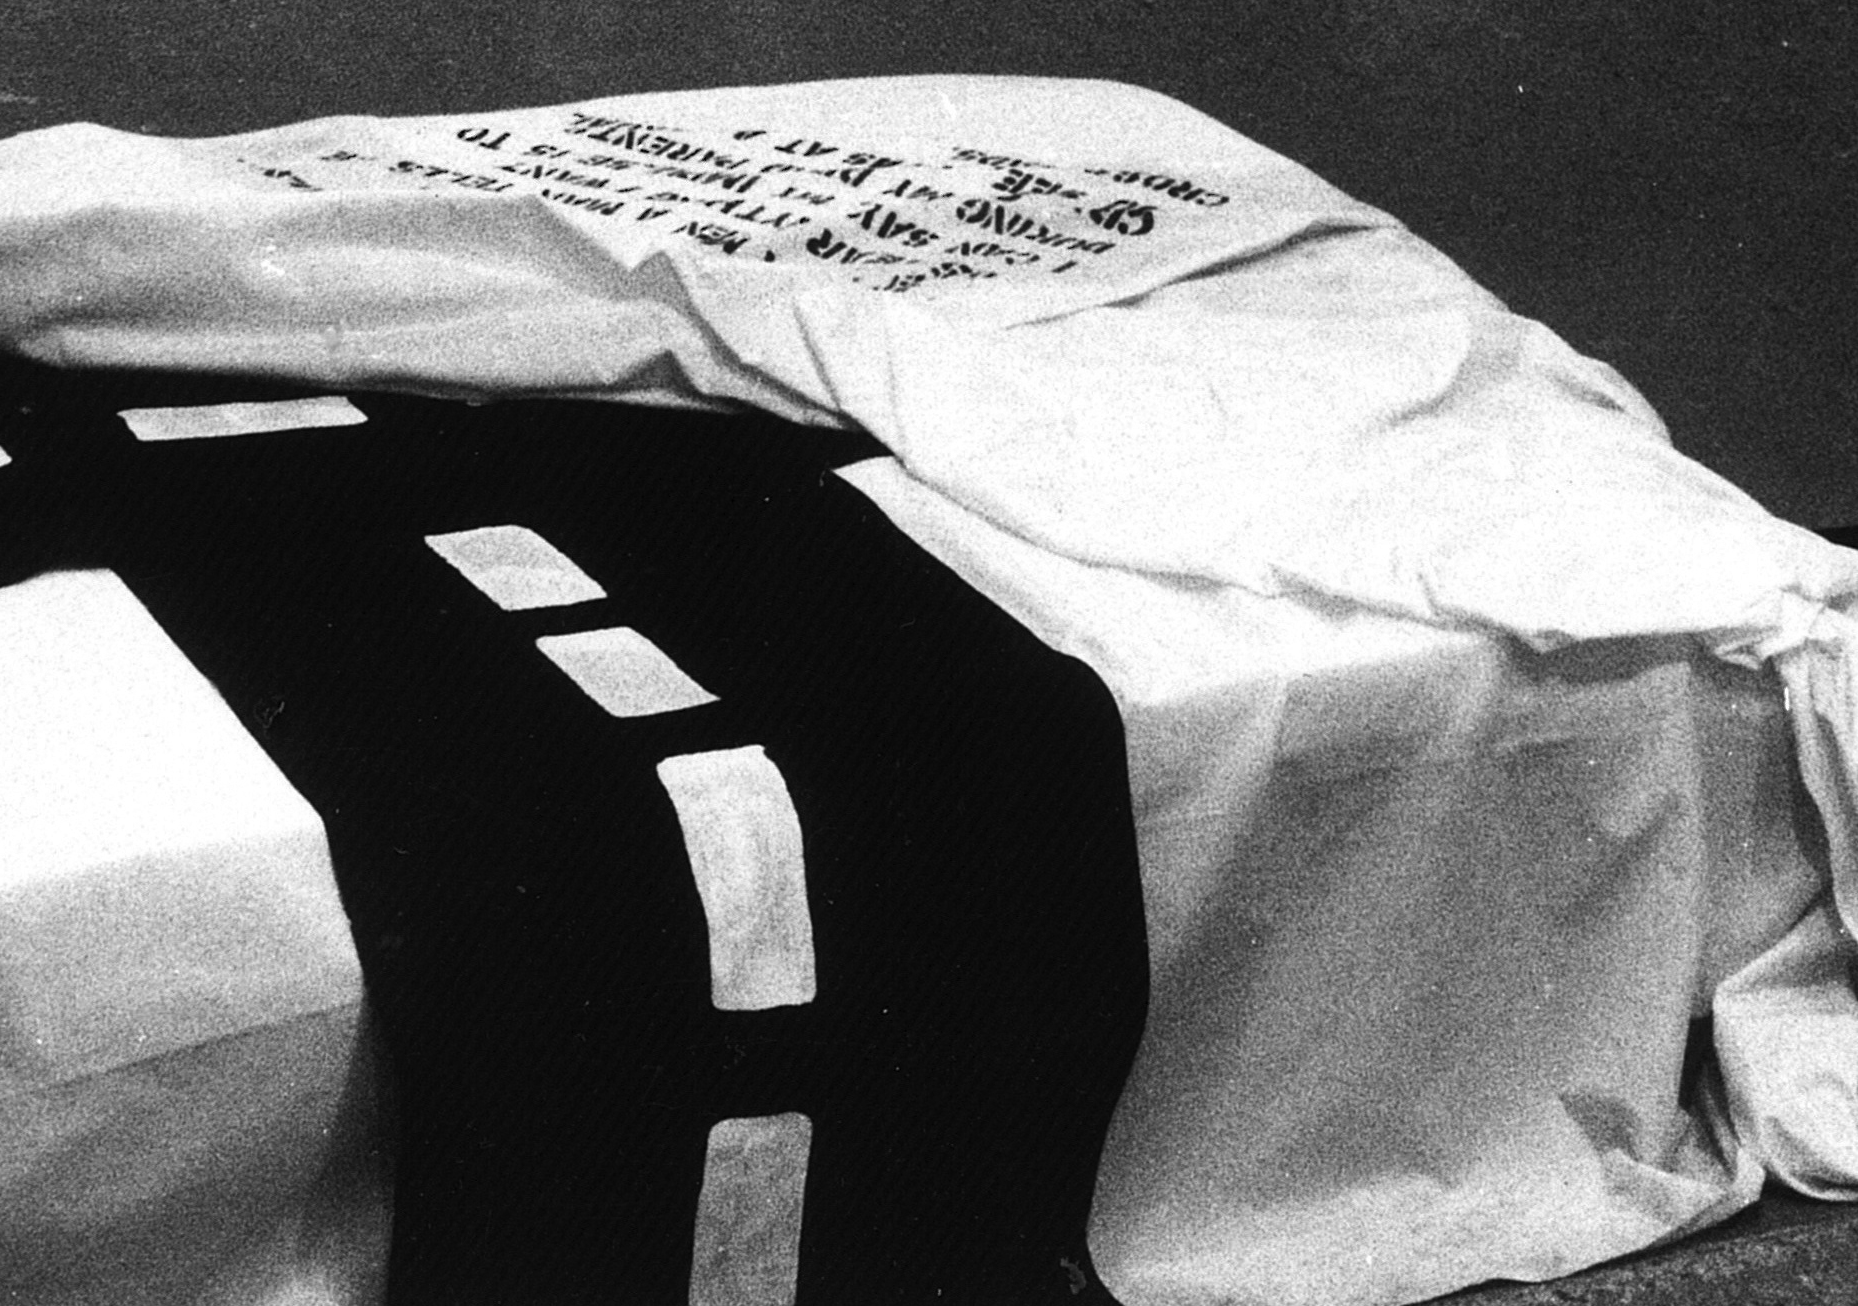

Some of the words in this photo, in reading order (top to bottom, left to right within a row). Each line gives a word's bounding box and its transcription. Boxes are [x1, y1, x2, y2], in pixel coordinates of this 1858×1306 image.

[457, 129, 511, 152] TO
[525, 145, 569, 159] IS
[773, 139, 840, 158] AT
[389, 160, 513, 193] TELLS
[501, 165, 610, 189] WANT
[956, 199, 1116, 255] DURING
[946, 242, 1042, 266] CAN
